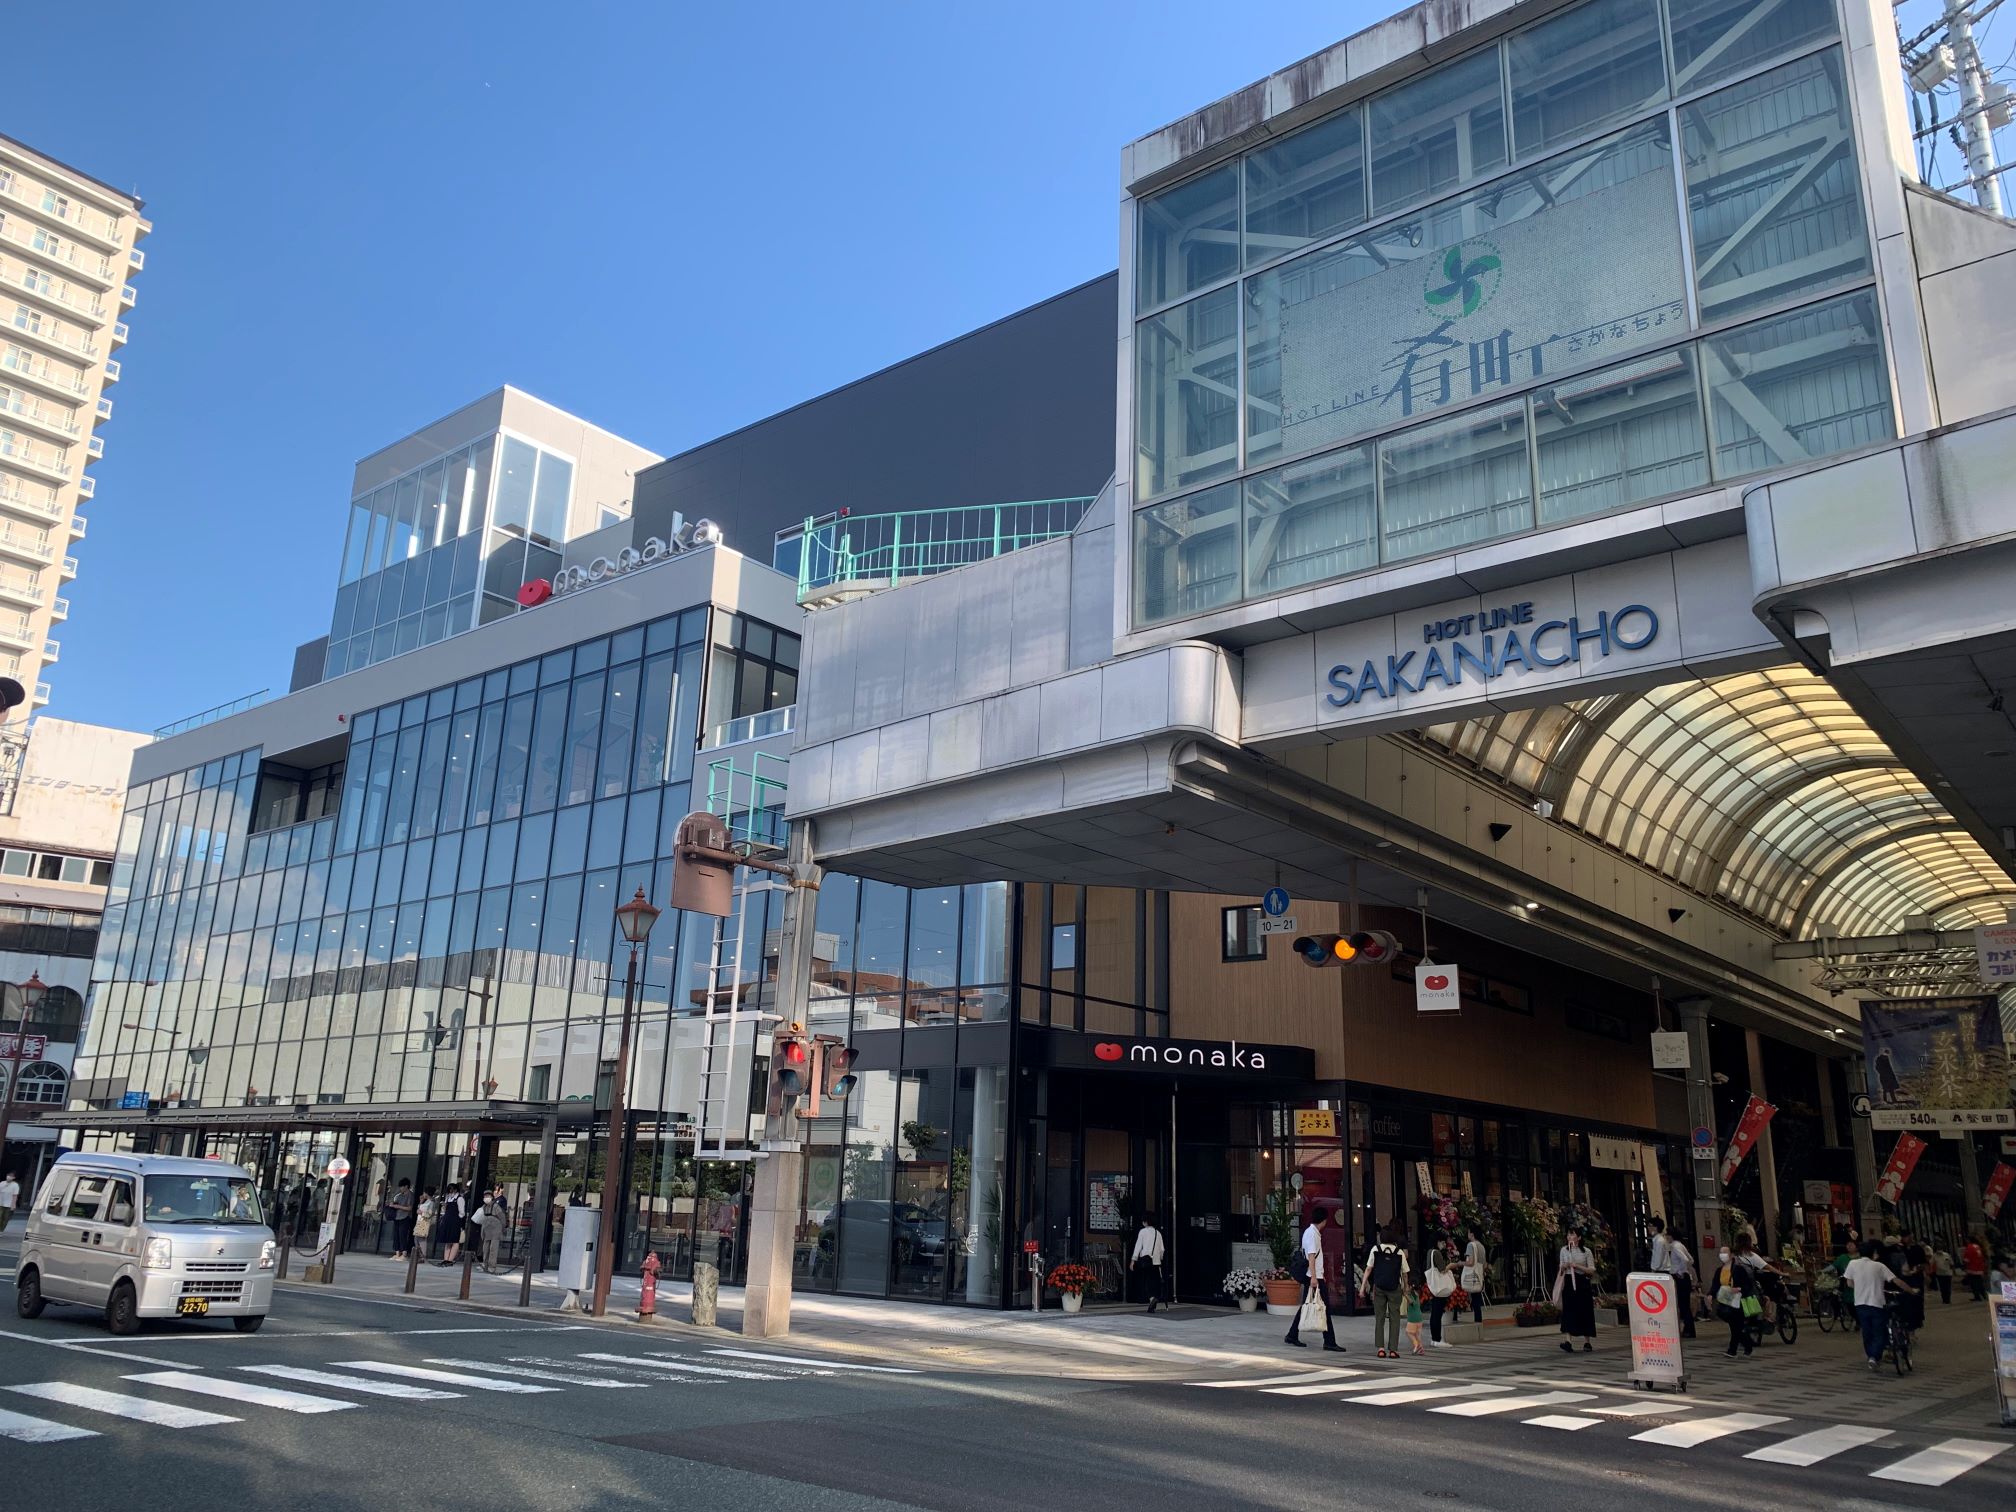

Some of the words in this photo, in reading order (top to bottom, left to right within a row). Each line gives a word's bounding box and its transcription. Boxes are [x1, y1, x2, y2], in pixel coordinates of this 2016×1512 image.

[1567, 302, 1683, 352] さかなちょう
[1283, 404, 1321, 426] HOT
[1331, 384, 1380, 410] LINE
[552, 510, 723, 595] monaka
[1423, 612, 1475, 644] HOT
[1477, 601, 1534, 632] LINE
[1326, 603, 1659, 707] SAKANACHO
[1420, 989, 1455, 998] monaka
[1130, 1039, 1265, 1069] monaka
[1933, 1031, 1964, 1099] 玄米茶
[1373, 1115, 1401, 1136] coffee
[183, 1303, 207, 1312] 22-70
